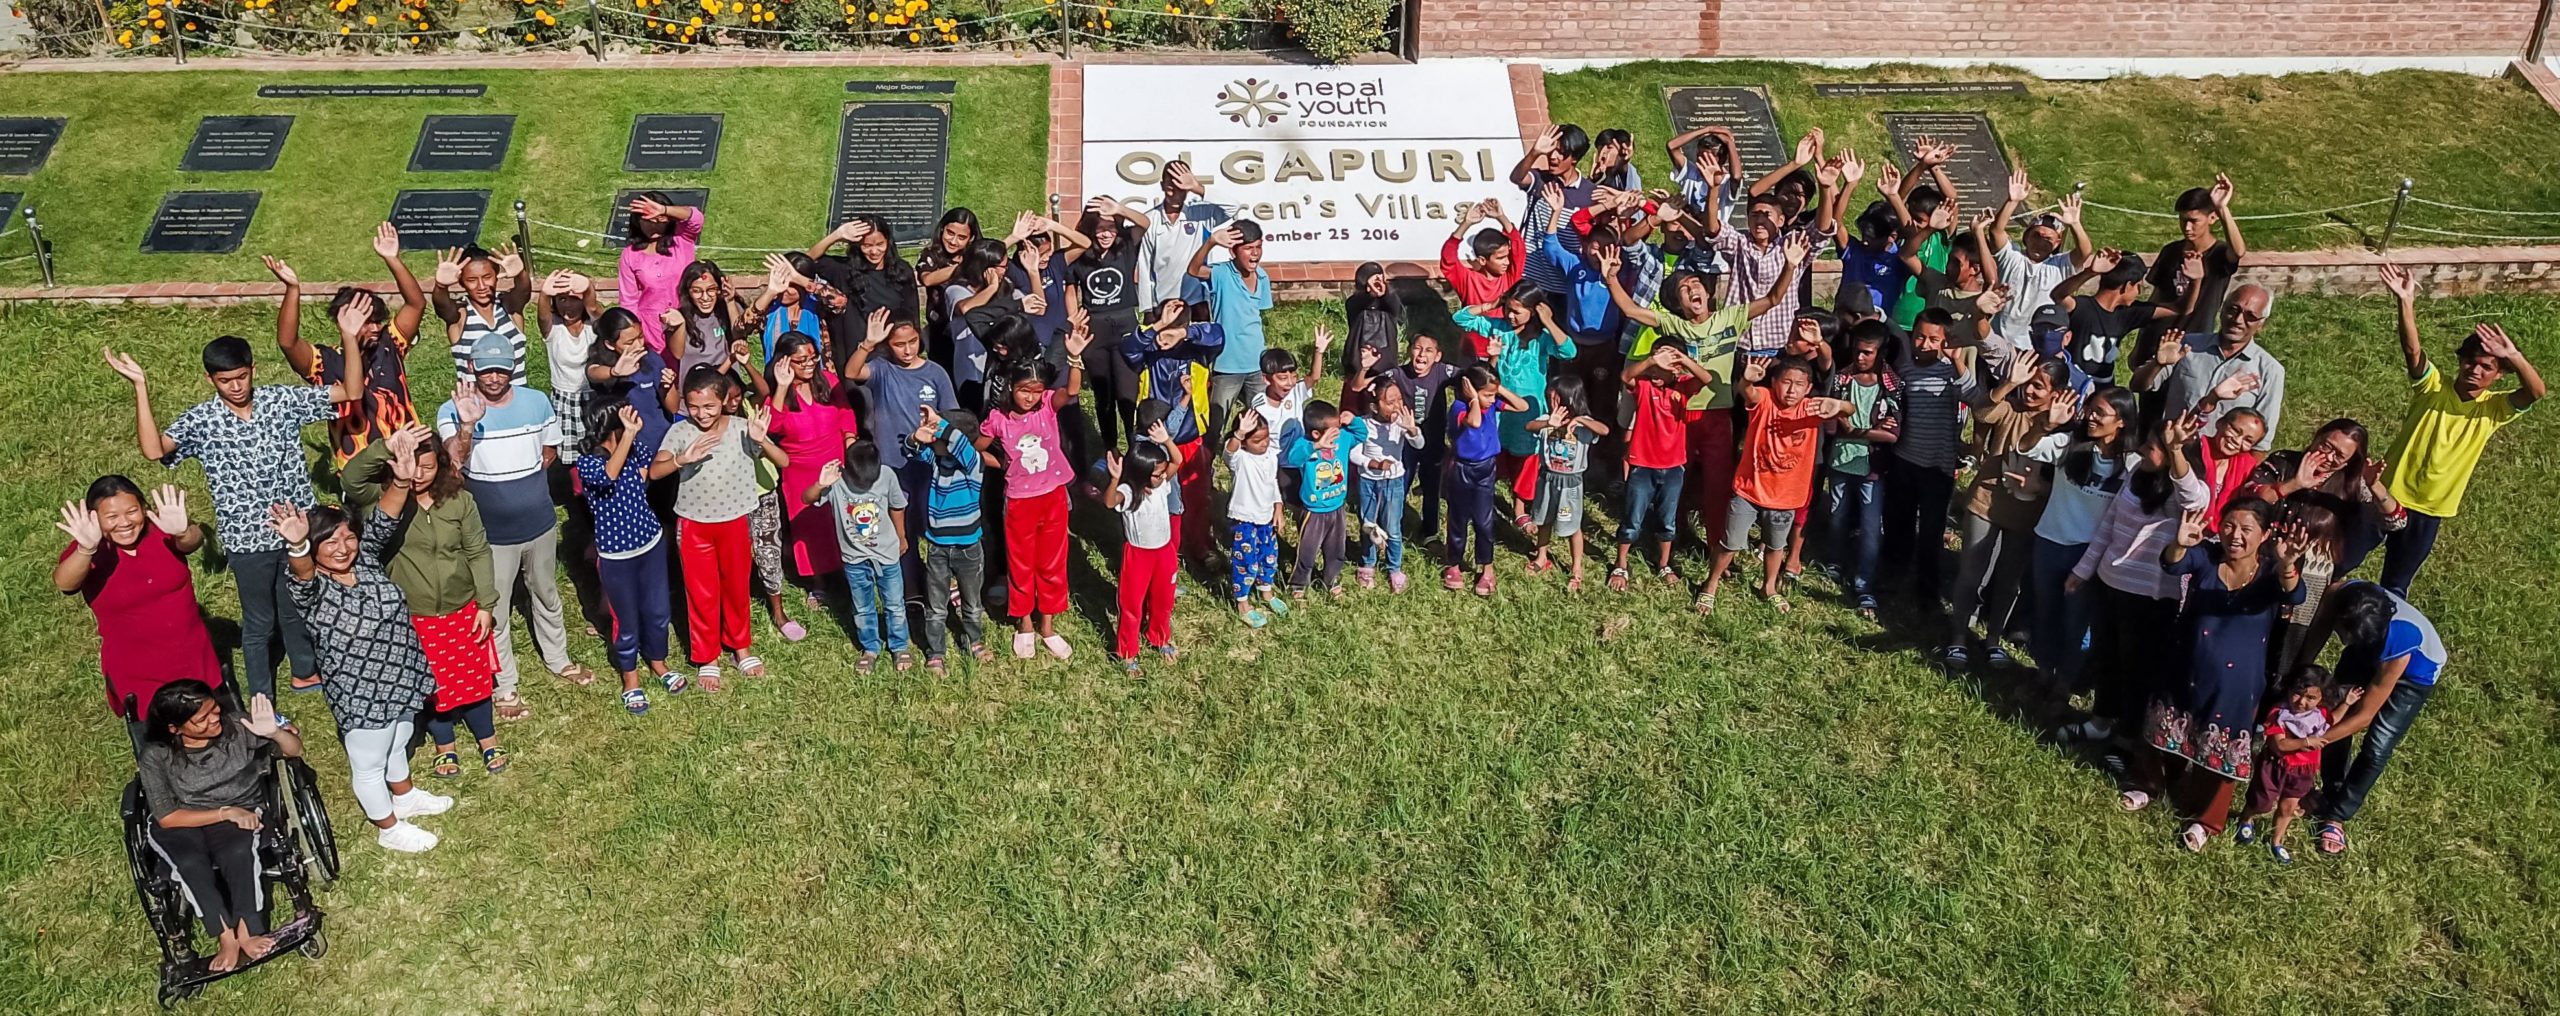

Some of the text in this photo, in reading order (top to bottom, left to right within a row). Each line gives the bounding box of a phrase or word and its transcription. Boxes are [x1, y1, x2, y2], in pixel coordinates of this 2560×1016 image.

[1295, 77, 1383, 99] nepal
[1298, 97, 1386, 118] youth
[1298, 120, 1388, 128] FOUNDATION
[1115, 149, 1496, 186] OLGAPURI
[1354, 192, 1475, 224] Villag
[1264, 228, 1400, 242] ember 25 2016
